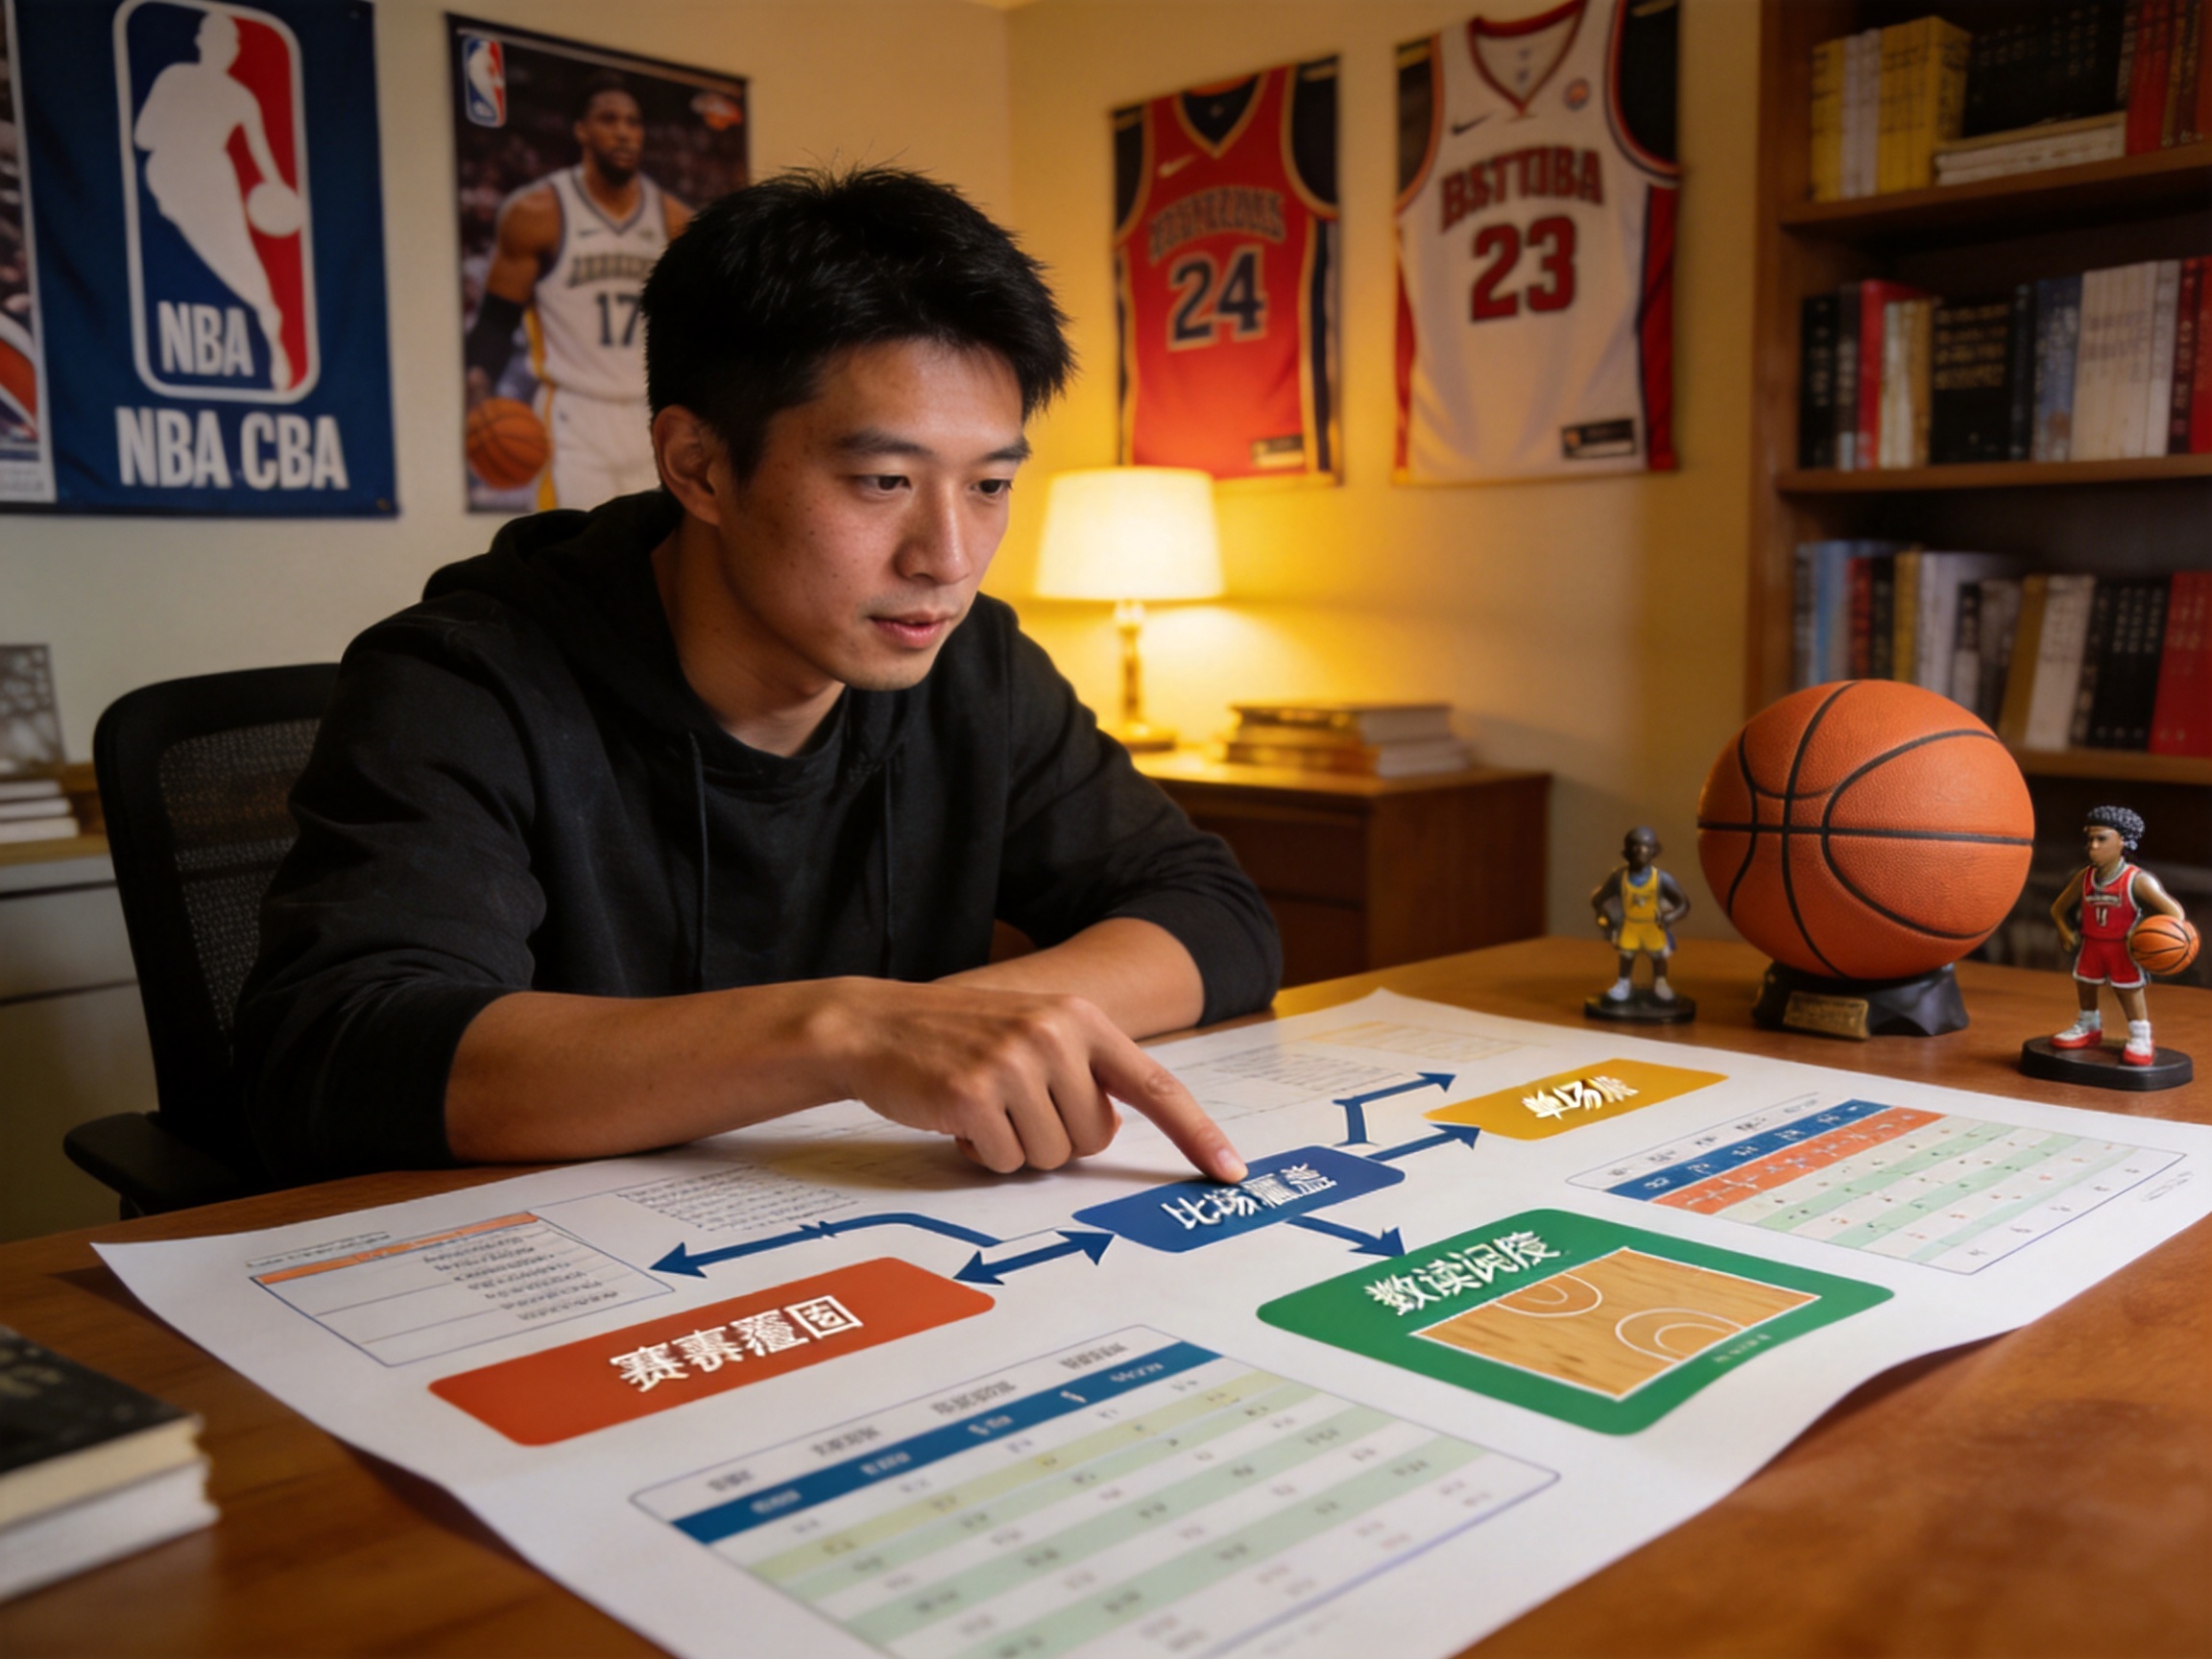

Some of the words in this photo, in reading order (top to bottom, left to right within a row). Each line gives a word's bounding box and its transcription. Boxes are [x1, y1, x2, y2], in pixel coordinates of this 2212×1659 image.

[1167, 249, 1268, 351] 24
[1470, 215, 1576, 324] 23
[157, 301, 254, 376] NBA
[595, 292, 643, 348] 17
[115, 405, 232, 489] NBA
[241, 411, 349, 491] CBA
